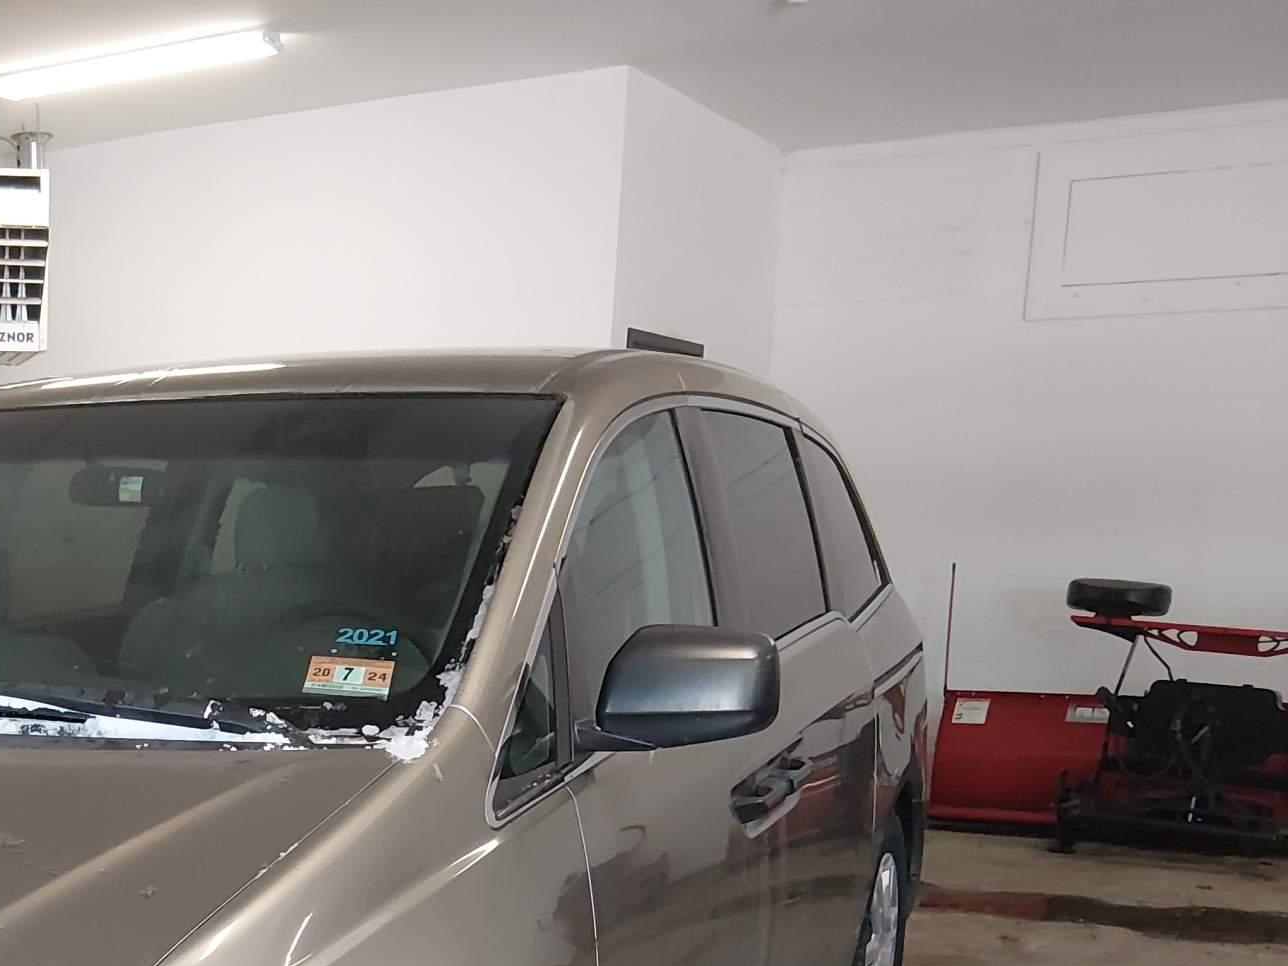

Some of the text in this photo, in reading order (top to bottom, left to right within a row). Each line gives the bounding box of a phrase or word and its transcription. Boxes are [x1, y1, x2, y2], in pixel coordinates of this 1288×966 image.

[336, 628, 398, 645] 2021
[312, 667, 387, 683] 20 7 24
